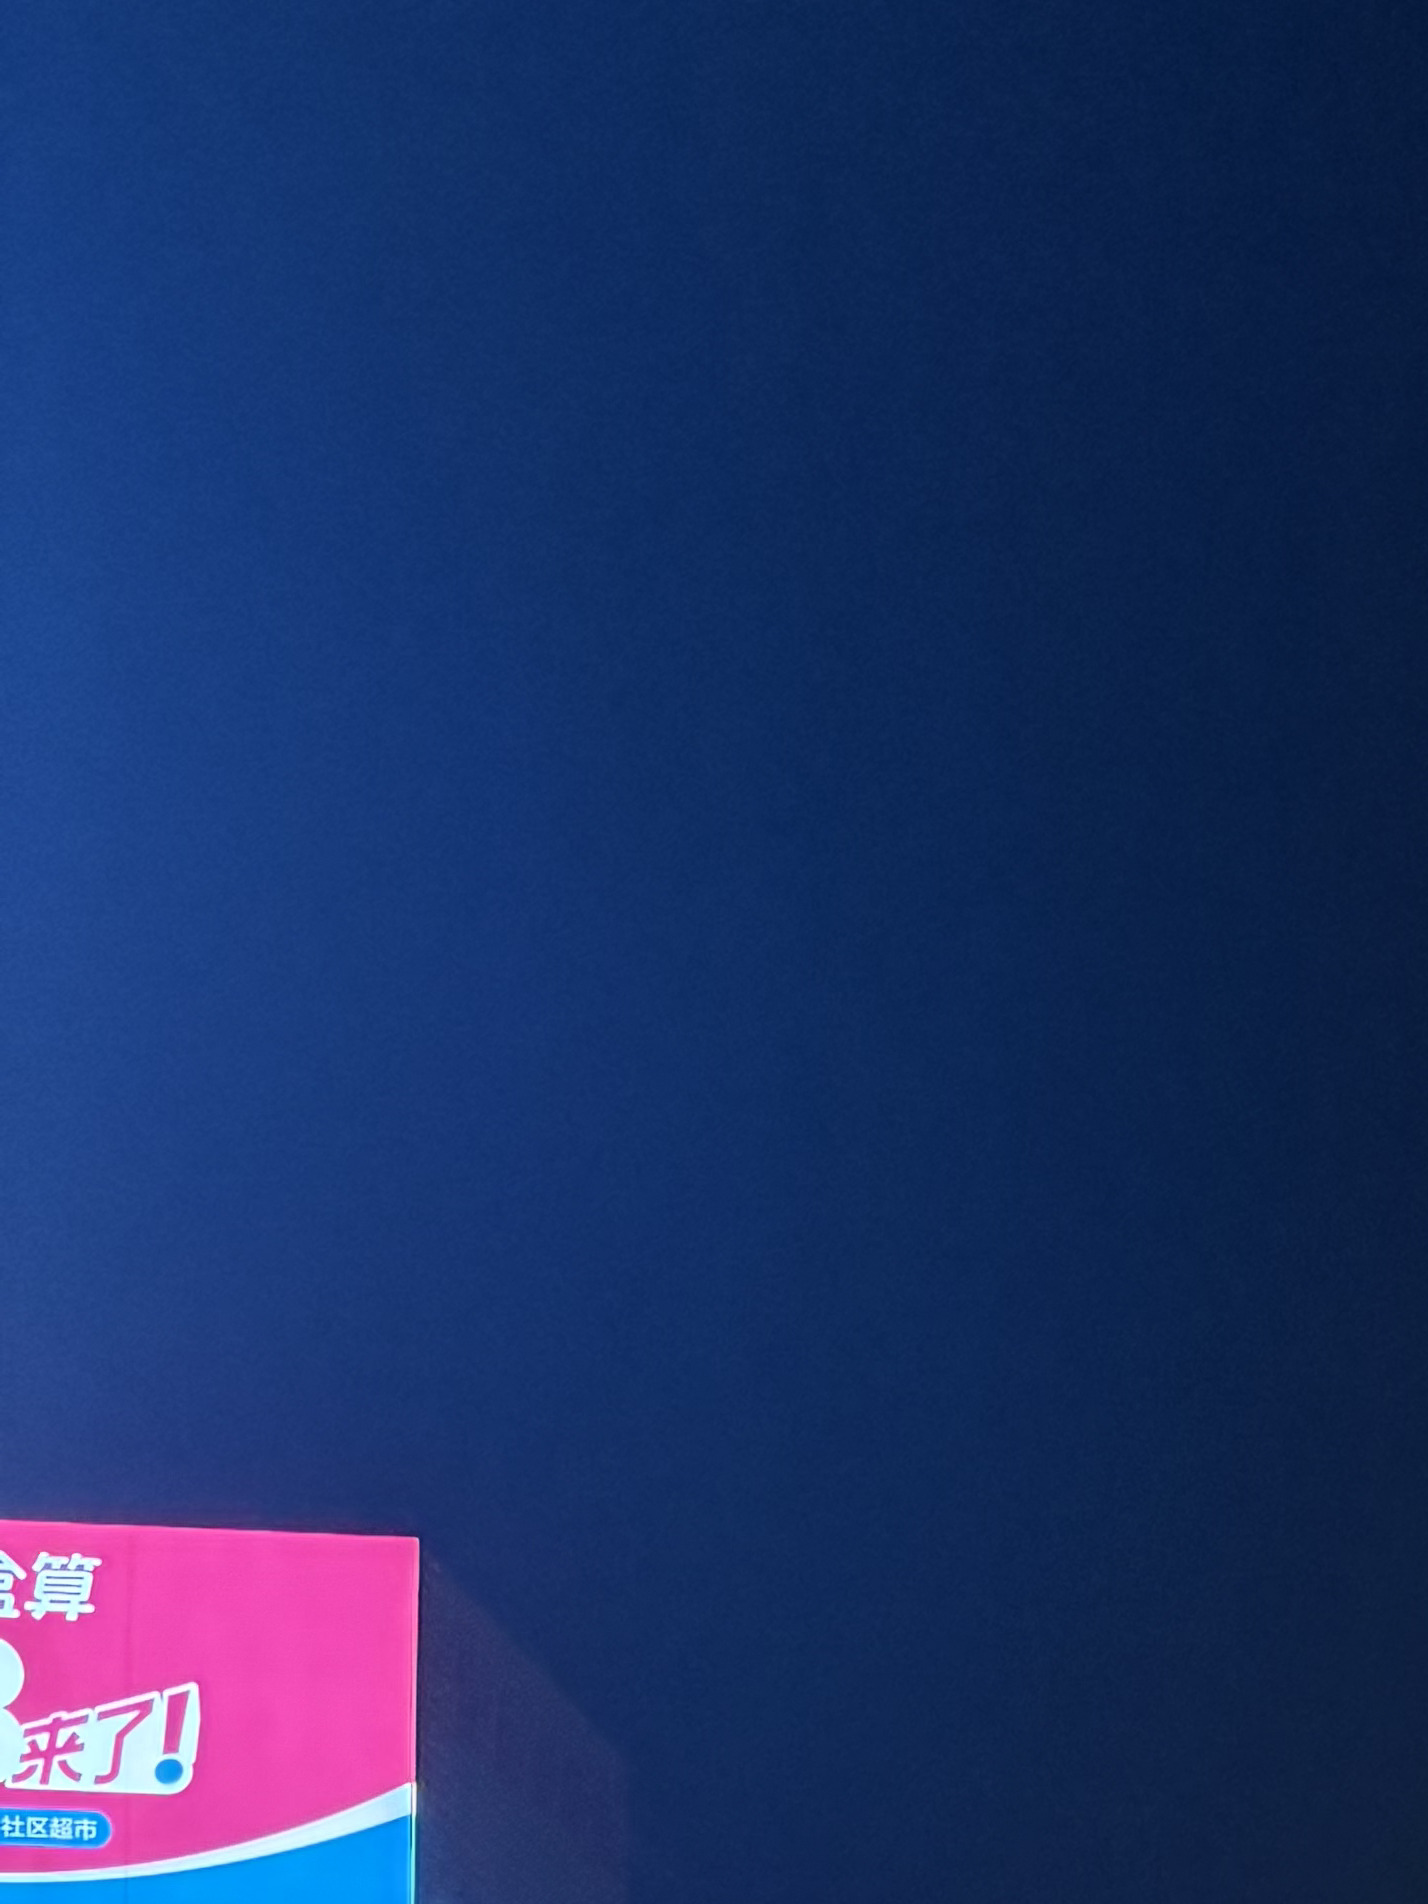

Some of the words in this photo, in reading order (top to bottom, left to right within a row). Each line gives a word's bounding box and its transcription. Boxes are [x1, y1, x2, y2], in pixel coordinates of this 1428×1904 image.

[10, 1686, 193, 1790] 来了!
[0, 1814, 98, 1842] 社区超市
